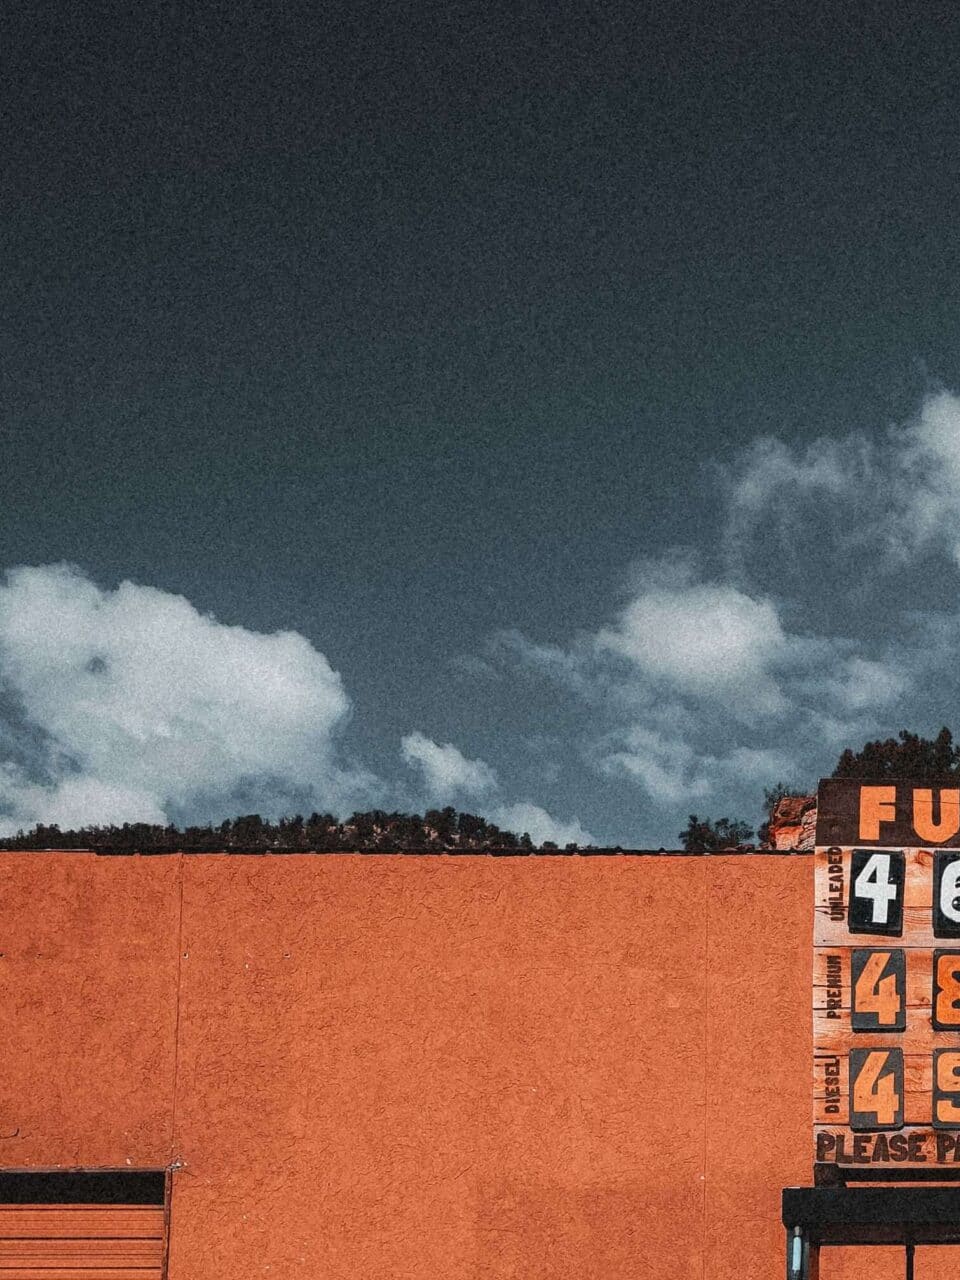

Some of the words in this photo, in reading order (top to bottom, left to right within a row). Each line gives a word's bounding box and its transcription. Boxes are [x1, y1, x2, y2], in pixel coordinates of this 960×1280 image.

[829, 846, 844, 922] UNLEADED
[826, 955, 842, 1020] PREMIUM
[824, 1055, 841, 1115] DIESEL
[816, 1132, 928, 1164] PLEASE
